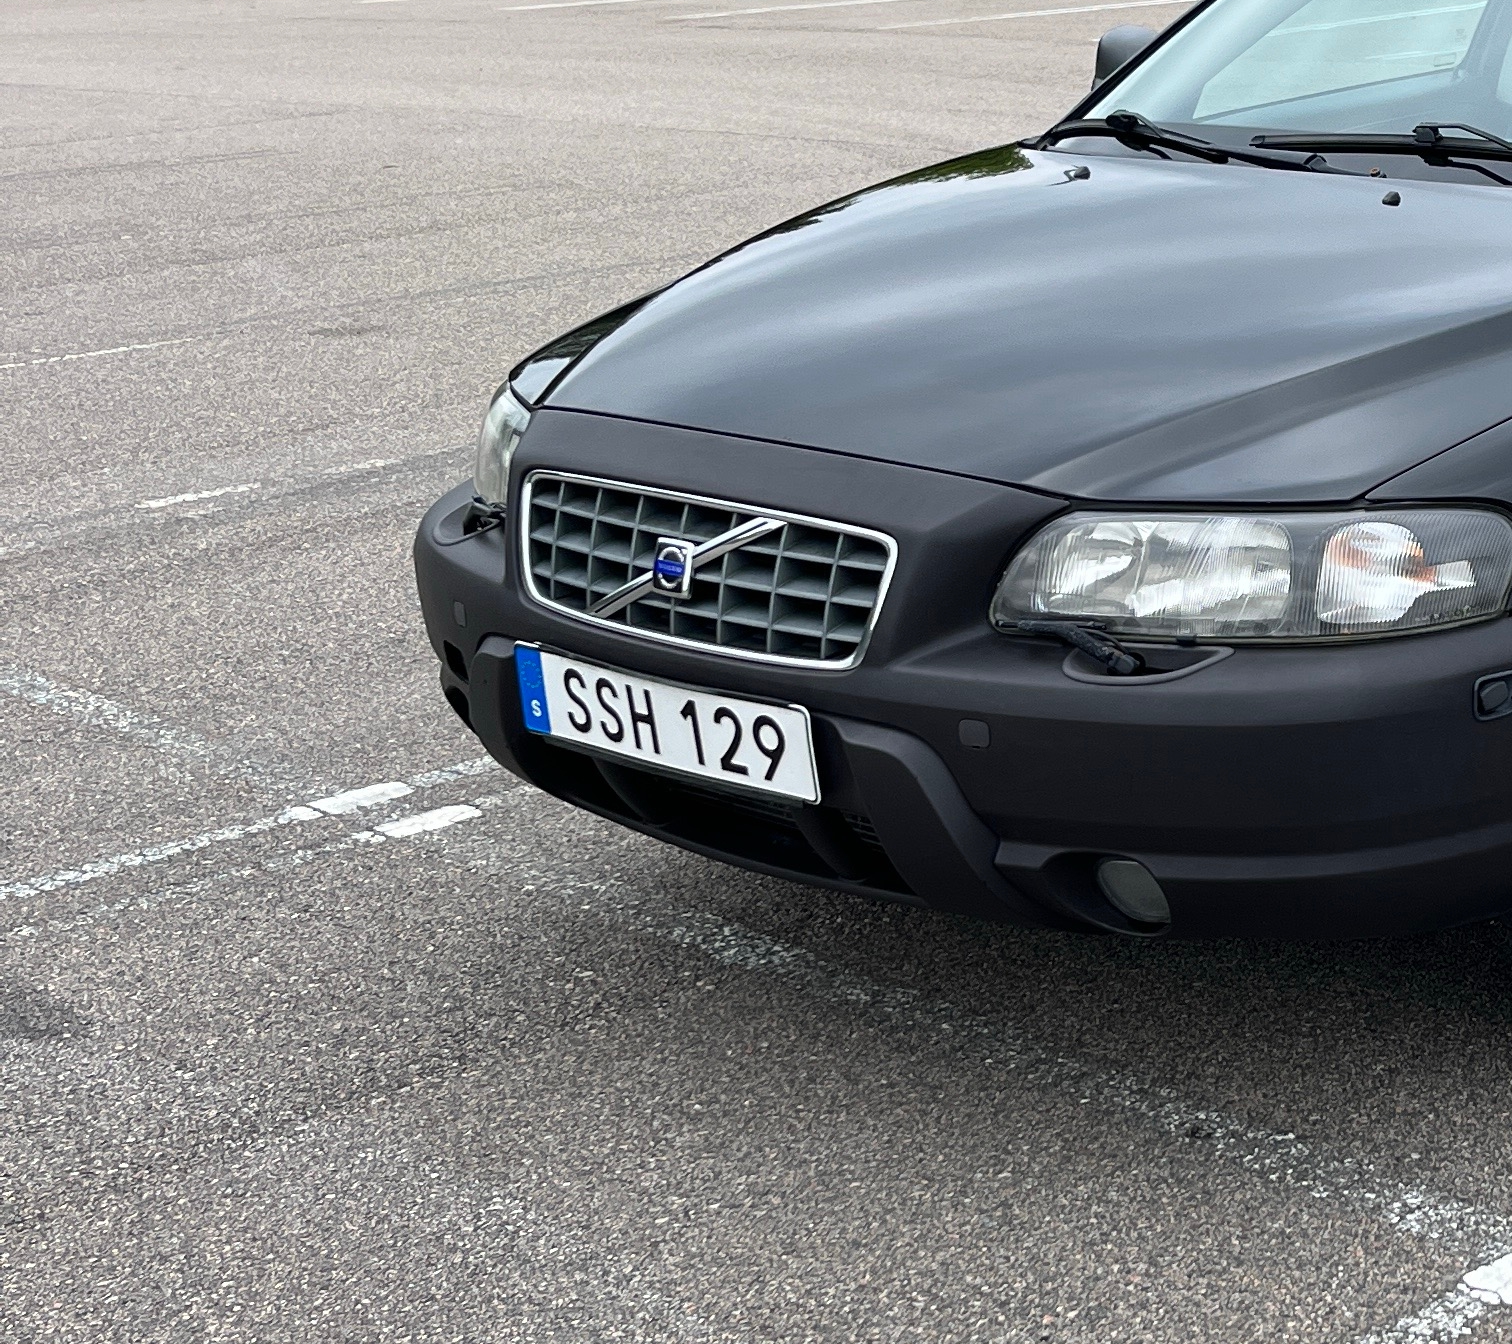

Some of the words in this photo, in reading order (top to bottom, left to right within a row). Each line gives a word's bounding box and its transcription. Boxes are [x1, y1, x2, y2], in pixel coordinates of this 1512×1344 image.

[530, 699, 543, 717] S
[563, 668, 661, 755] SSH
[680, 699, 786, 781] 129
